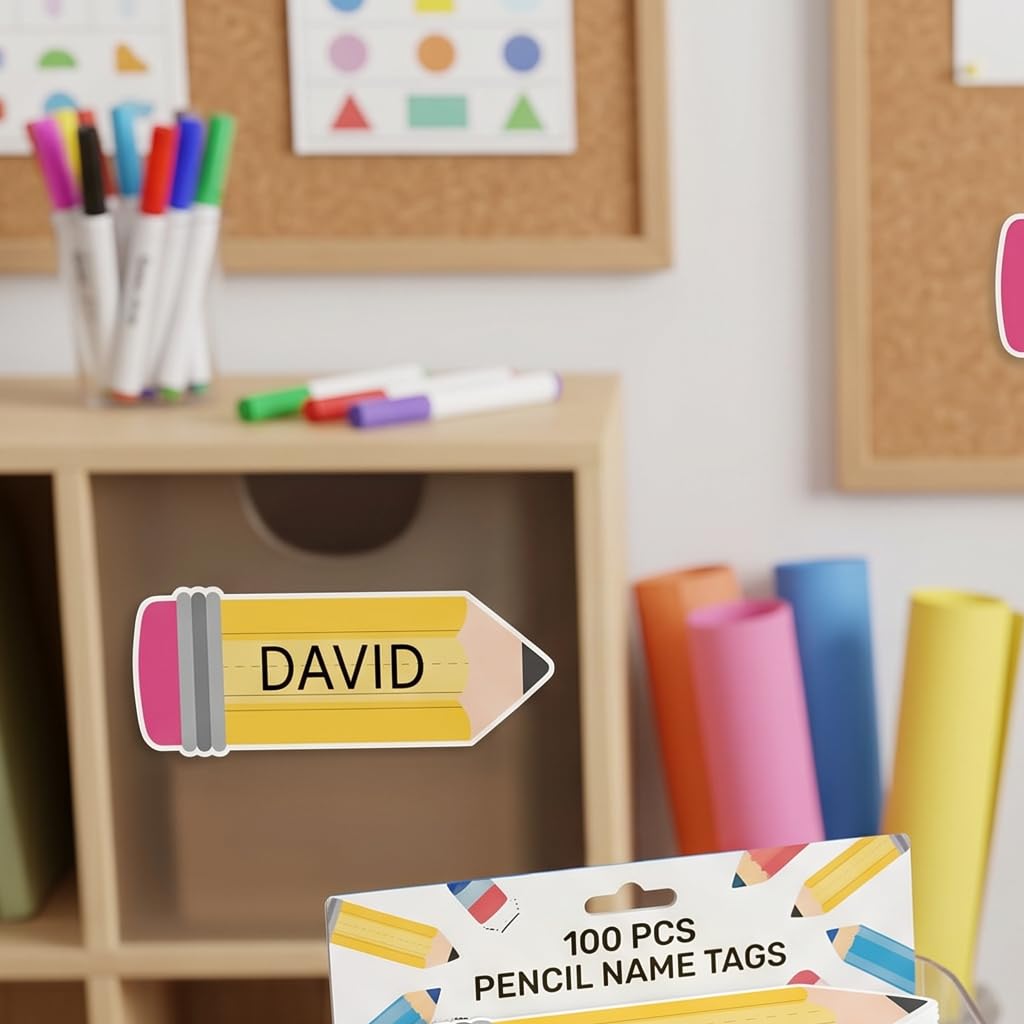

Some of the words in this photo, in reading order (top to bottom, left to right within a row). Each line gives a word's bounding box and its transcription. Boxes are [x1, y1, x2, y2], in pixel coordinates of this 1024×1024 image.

[261, 644, 425, 691] DAVID
[563, 926, 621, 956] 100
[632, 917, 696, 949] PCS
[474, 964, 594, 1001] PENCIL
[602, 950, 696, 987] NAME
[703, 941, 787, 974] TAGS
